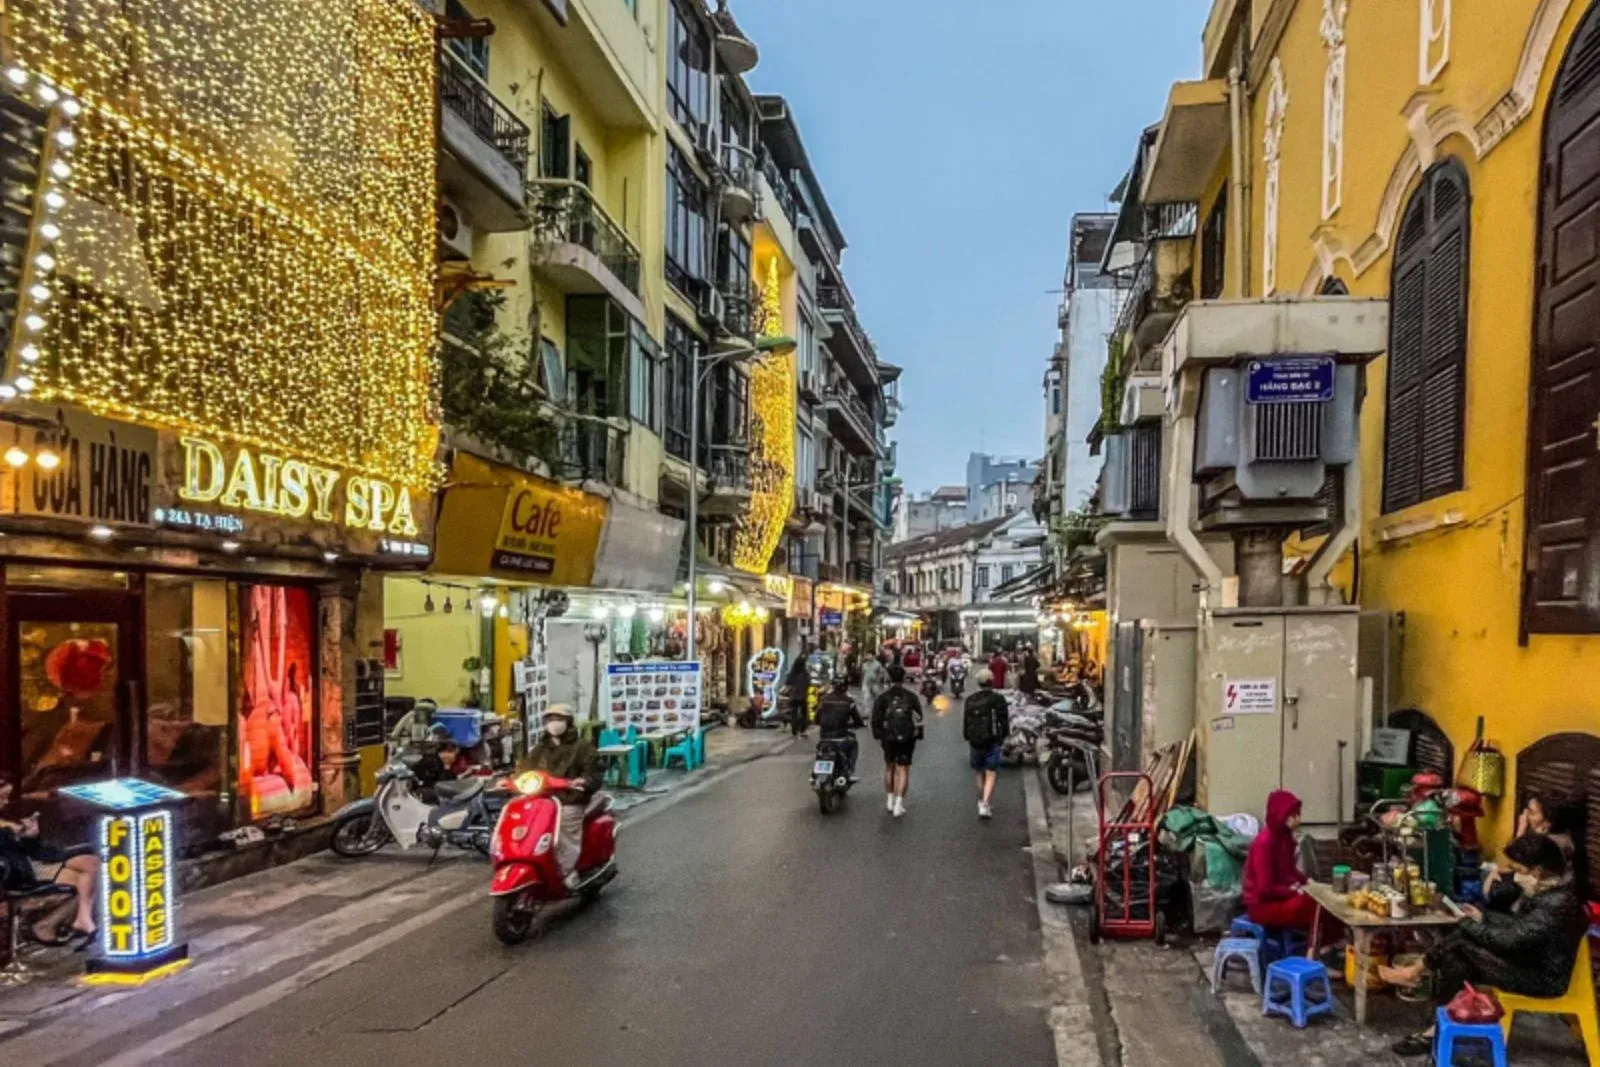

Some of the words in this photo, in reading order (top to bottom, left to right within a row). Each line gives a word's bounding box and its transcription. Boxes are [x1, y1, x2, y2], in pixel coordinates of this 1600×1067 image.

[90, 430, 150, 524] HÀNG
[179, 435, 341, 522] DAISY
[345, 475, 417, 536] SPA
[109, 819, 132, 951] FOOT
[143, 818, 165, 945] MASSAGE
